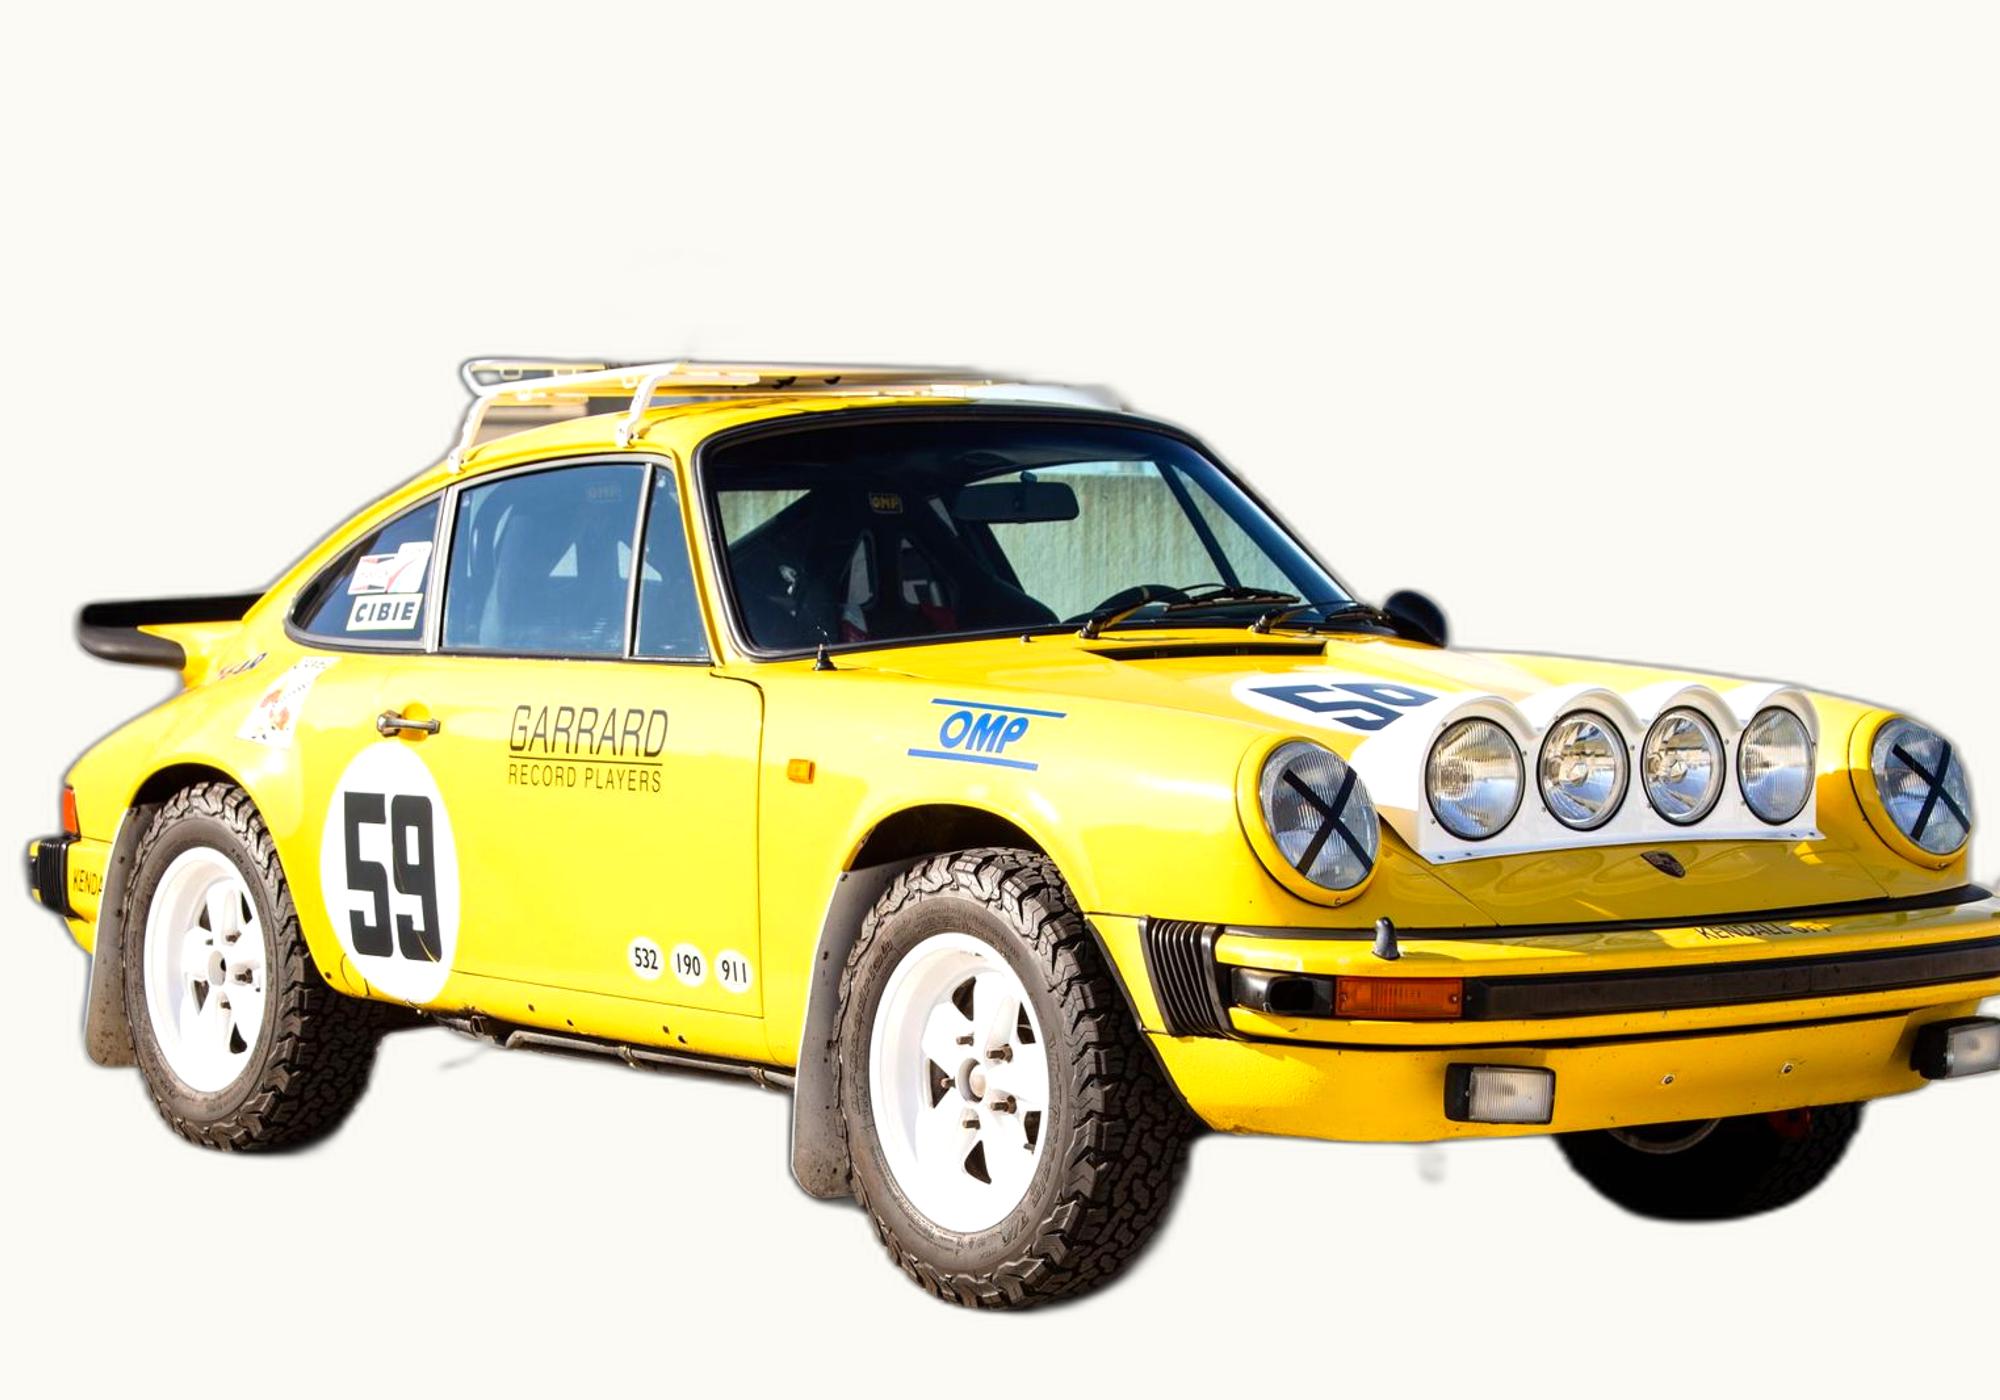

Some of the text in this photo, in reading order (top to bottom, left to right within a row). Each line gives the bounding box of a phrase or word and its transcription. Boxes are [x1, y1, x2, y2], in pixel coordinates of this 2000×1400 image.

[355, 602, 416, 622] CIBIE
[509, 704, 668, 758] GARRARD
[939, 710, 1029, 753] OMP
[508, 763, 661, 793] RECORD PLAYERS
[344, 791, 442, 962] 59
[635, 946, 659, 970] 532
[677, 952, 701, 977] 190
[721, 959, 747, 984] 911
